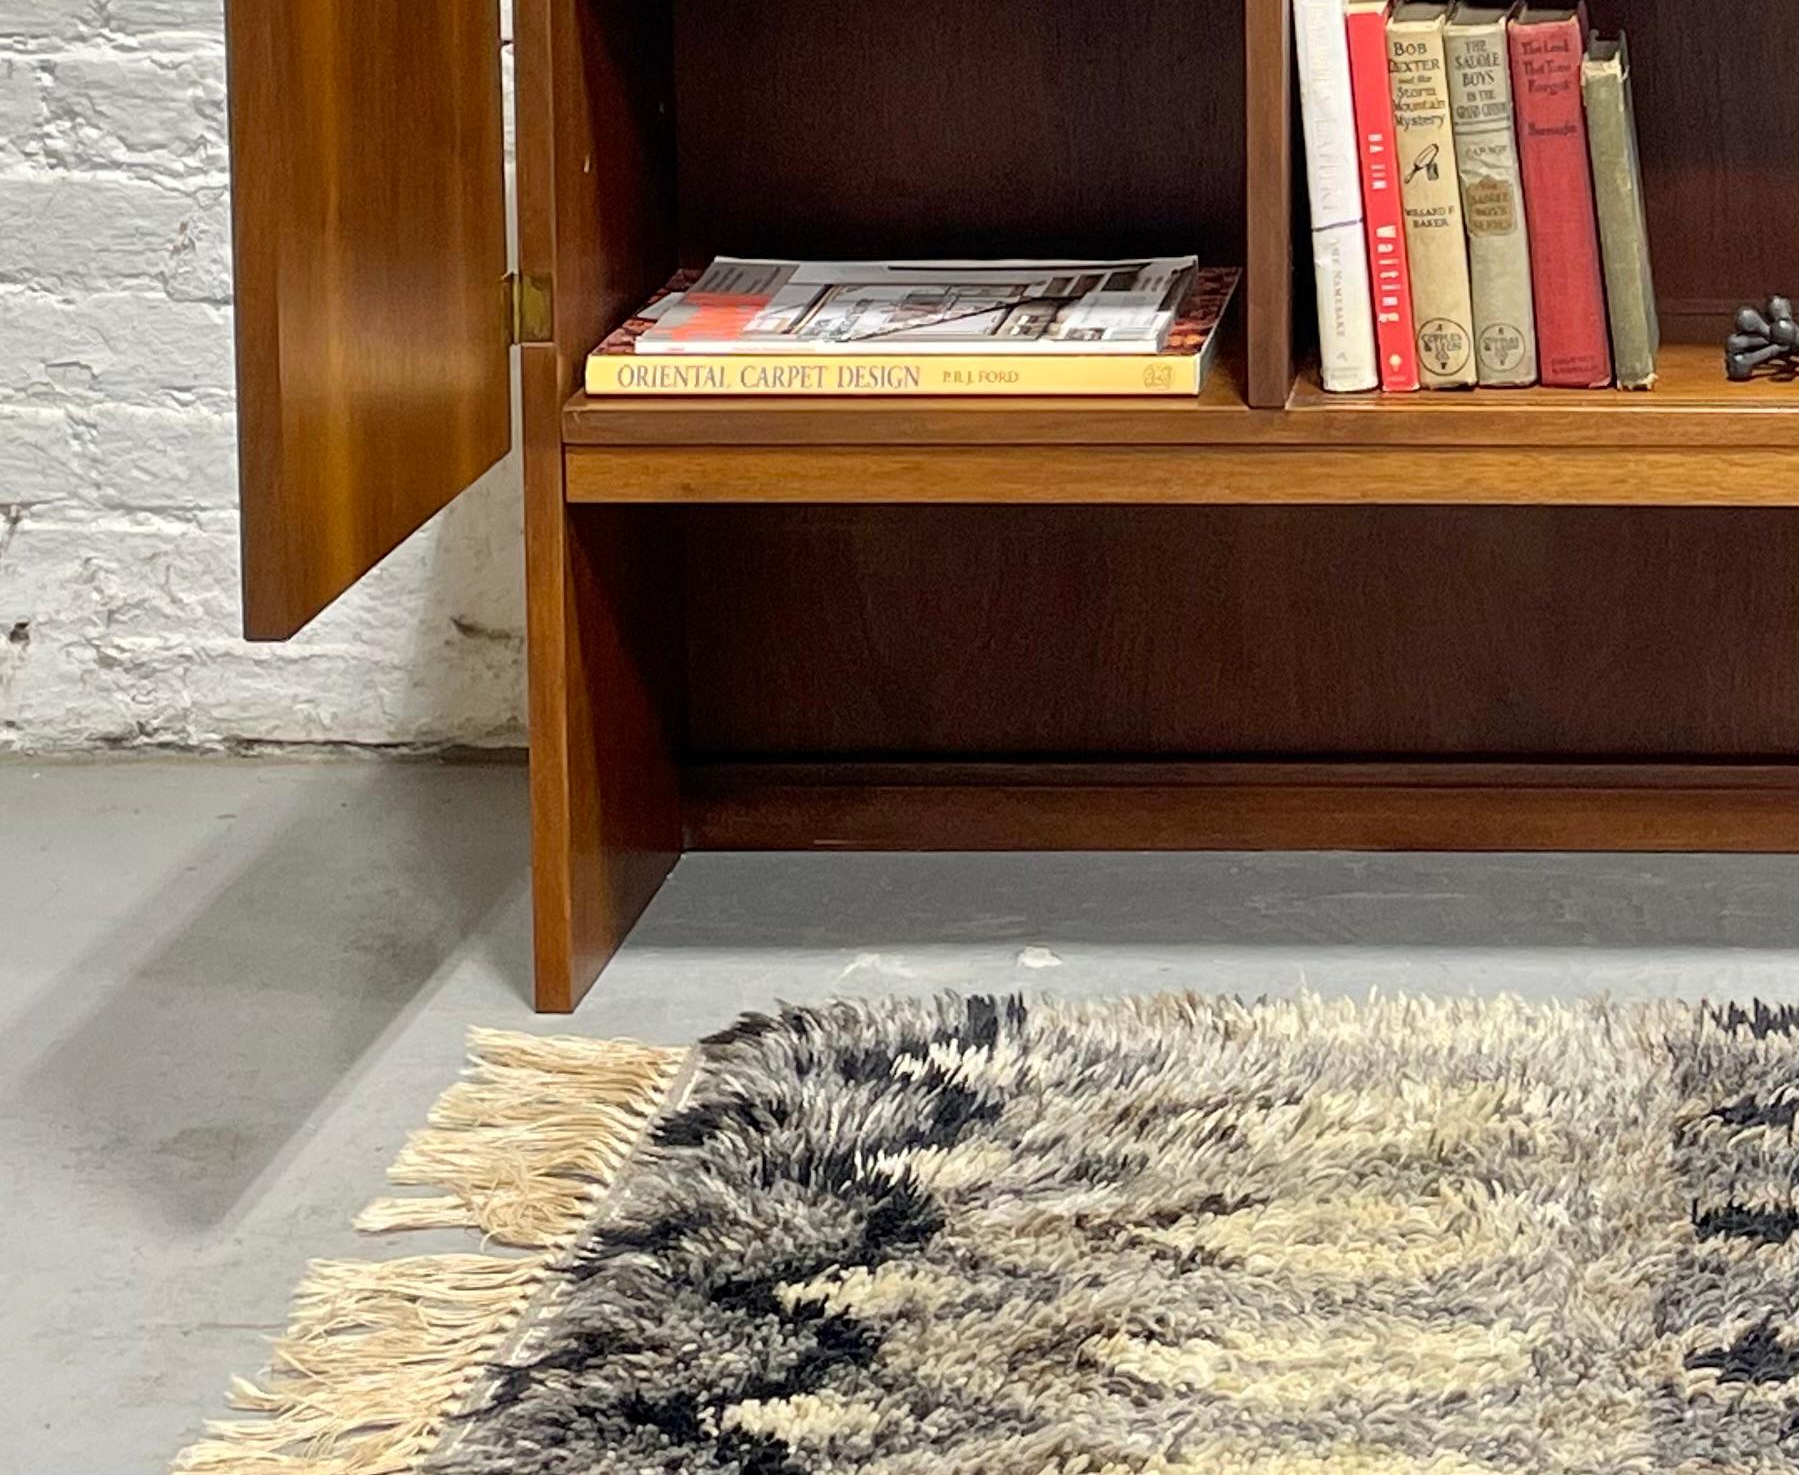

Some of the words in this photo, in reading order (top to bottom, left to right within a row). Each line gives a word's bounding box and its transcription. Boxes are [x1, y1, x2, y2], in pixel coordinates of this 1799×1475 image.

[1393, 42, 1428, 56] BOB
[1465, 40, 1487, 53] THE
[1387, 59, 1441, 73] DEXTER
[1463, 70, 1495, 87] BOYS
[1412, 218, 1449, 229] BAKER
[1376, 224, 1400, 324] Waiting
[617, 363, 730, 389] ORIENTAL
[740, 363, 828, 389] CARPET
[837, 363, 921, 389] DESIGN
[978, 370, 1020, 384] FORD
